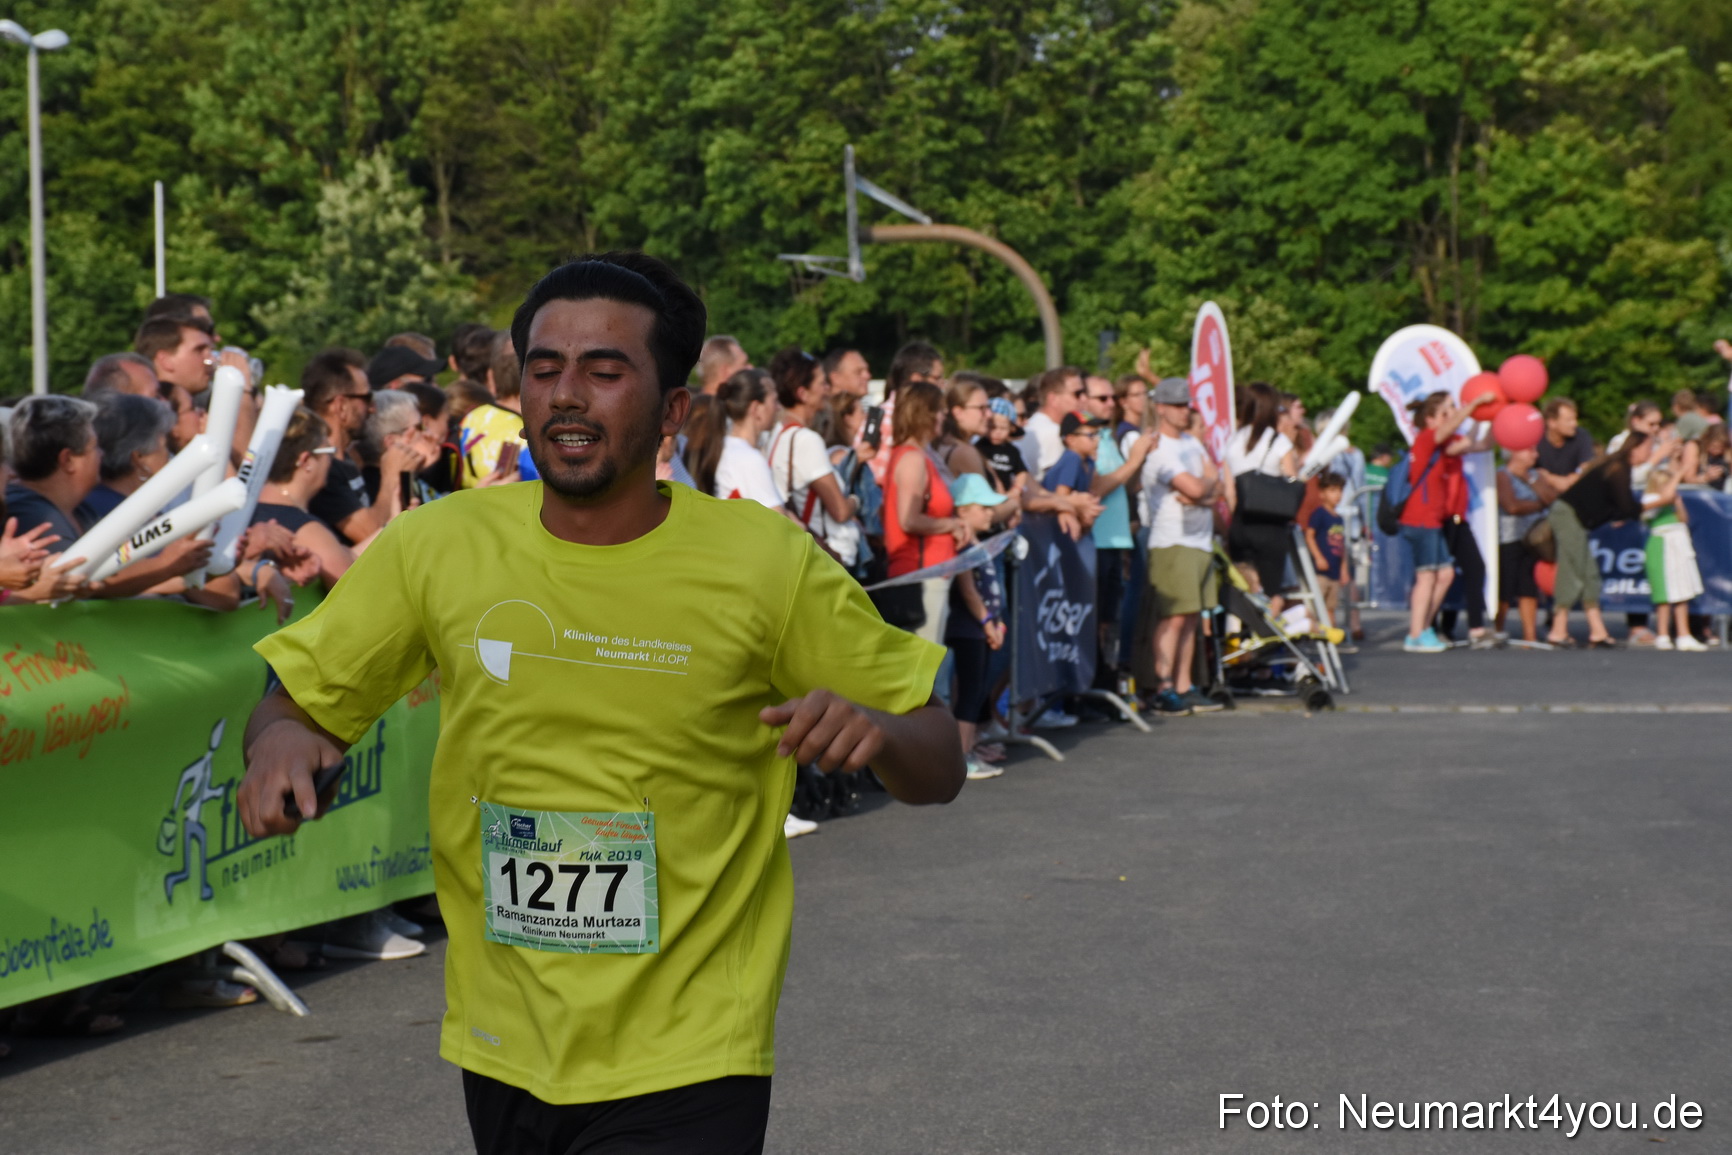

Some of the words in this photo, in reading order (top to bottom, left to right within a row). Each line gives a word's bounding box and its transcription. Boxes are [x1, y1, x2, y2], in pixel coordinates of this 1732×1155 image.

[563, 629, 608, 644] Kliniken
[611, 635, 630, 647] des
[632, 638, 692, 653] Landkreises
[595, 648, 650, 662] Neumarkt
[652, 652, 689, 666] i.d.OPf.
[502, 832, 563, 853] firmenlauf
[222, 836, 297, 887] neumarkt
[579, 850, 602, 862] run
[607, 850, 642, 862] 2019
[501, 857, 628, 913] 1277
[497, 905, 579, 928] Ramanzanzda
[583, 916, 641, 928] Murtaza
[521, 925, 557, 938] Klinikum
[559, 928, 606, 940] Neumarkt
